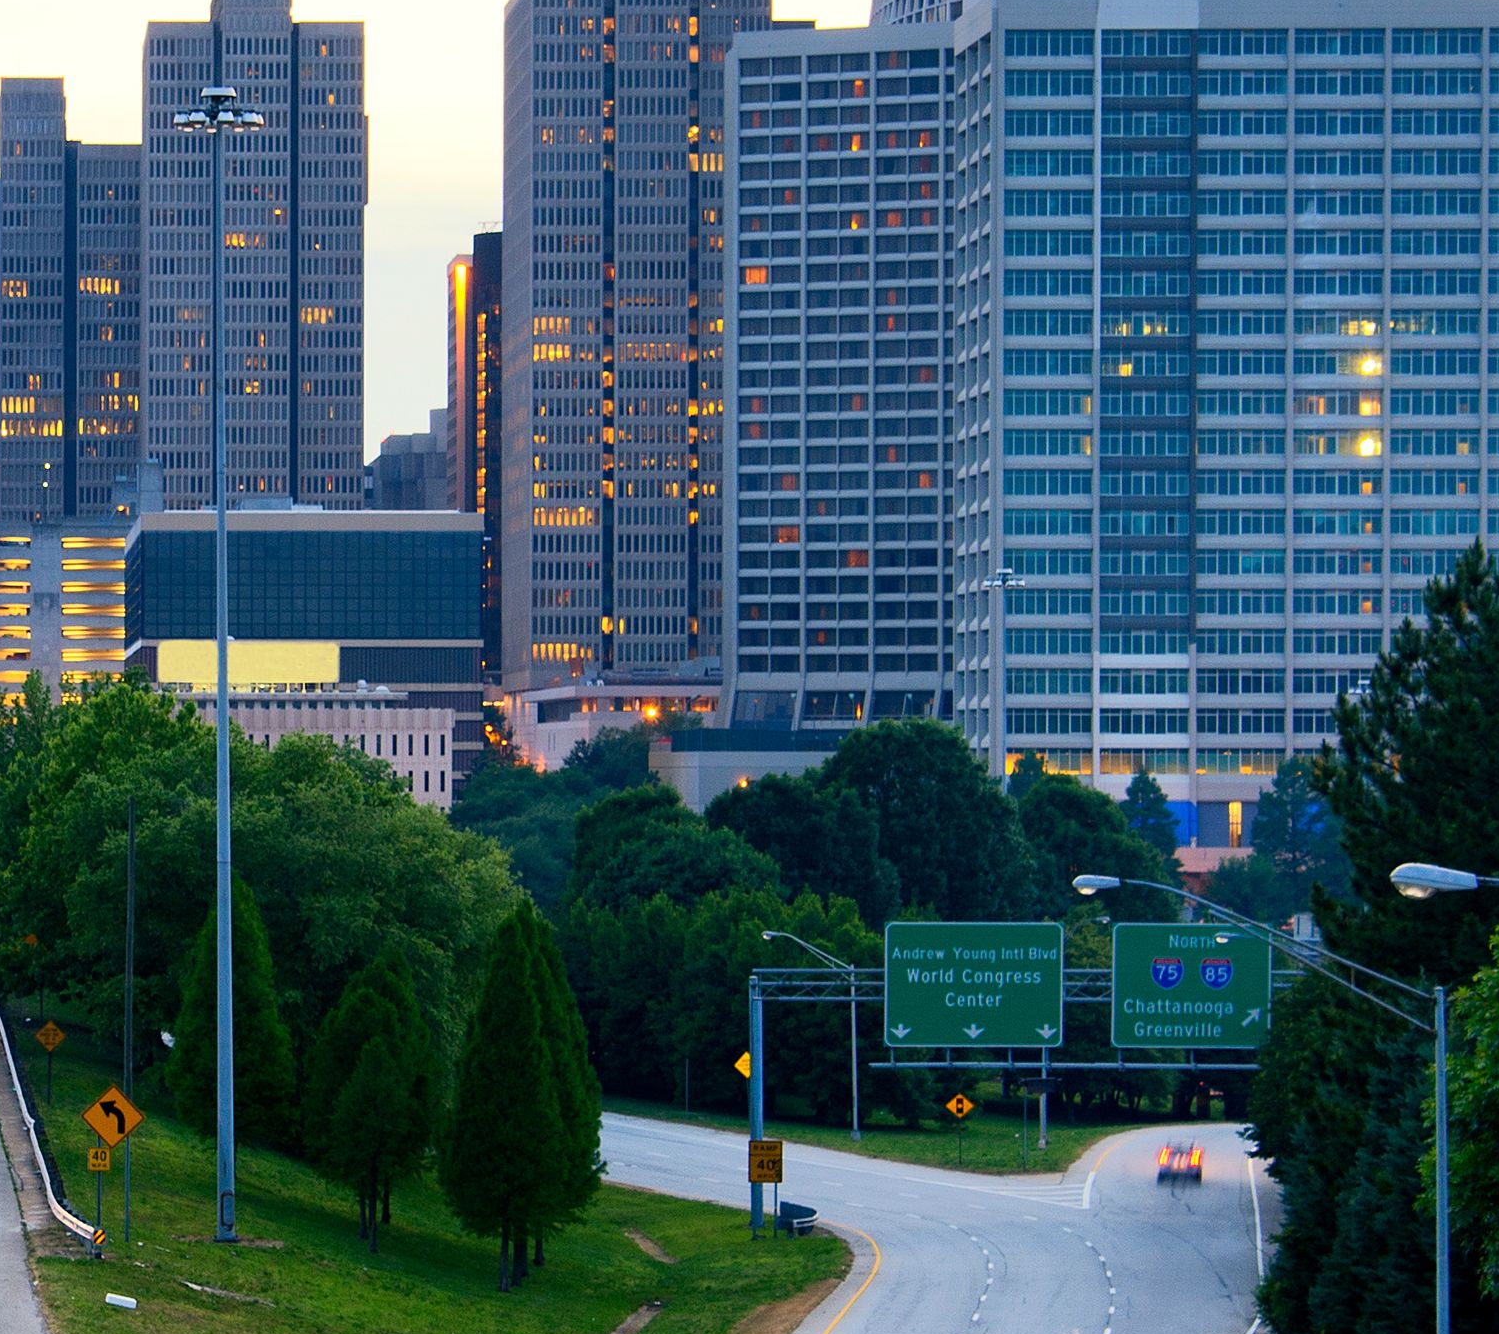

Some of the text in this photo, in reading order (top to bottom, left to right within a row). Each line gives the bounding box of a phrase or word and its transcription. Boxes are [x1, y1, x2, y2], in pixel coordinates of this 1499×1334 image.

[1169, 935, 1216, 948] NORTH
[892, 947, 1057, 963] Andrew Young Intl Blvd
[907, 968, 1042, 987] World Congress
[1156, 965, 1178, 980] 75
[1205, 967, 1228, 982] 85
[945, 992, 1002, 1007] Center
[1123, 999, 1234, 1018] Chattanooga
[1134, 1022, 1222, 1037] Greenville
[92, 1150, 107, 1162] 40
